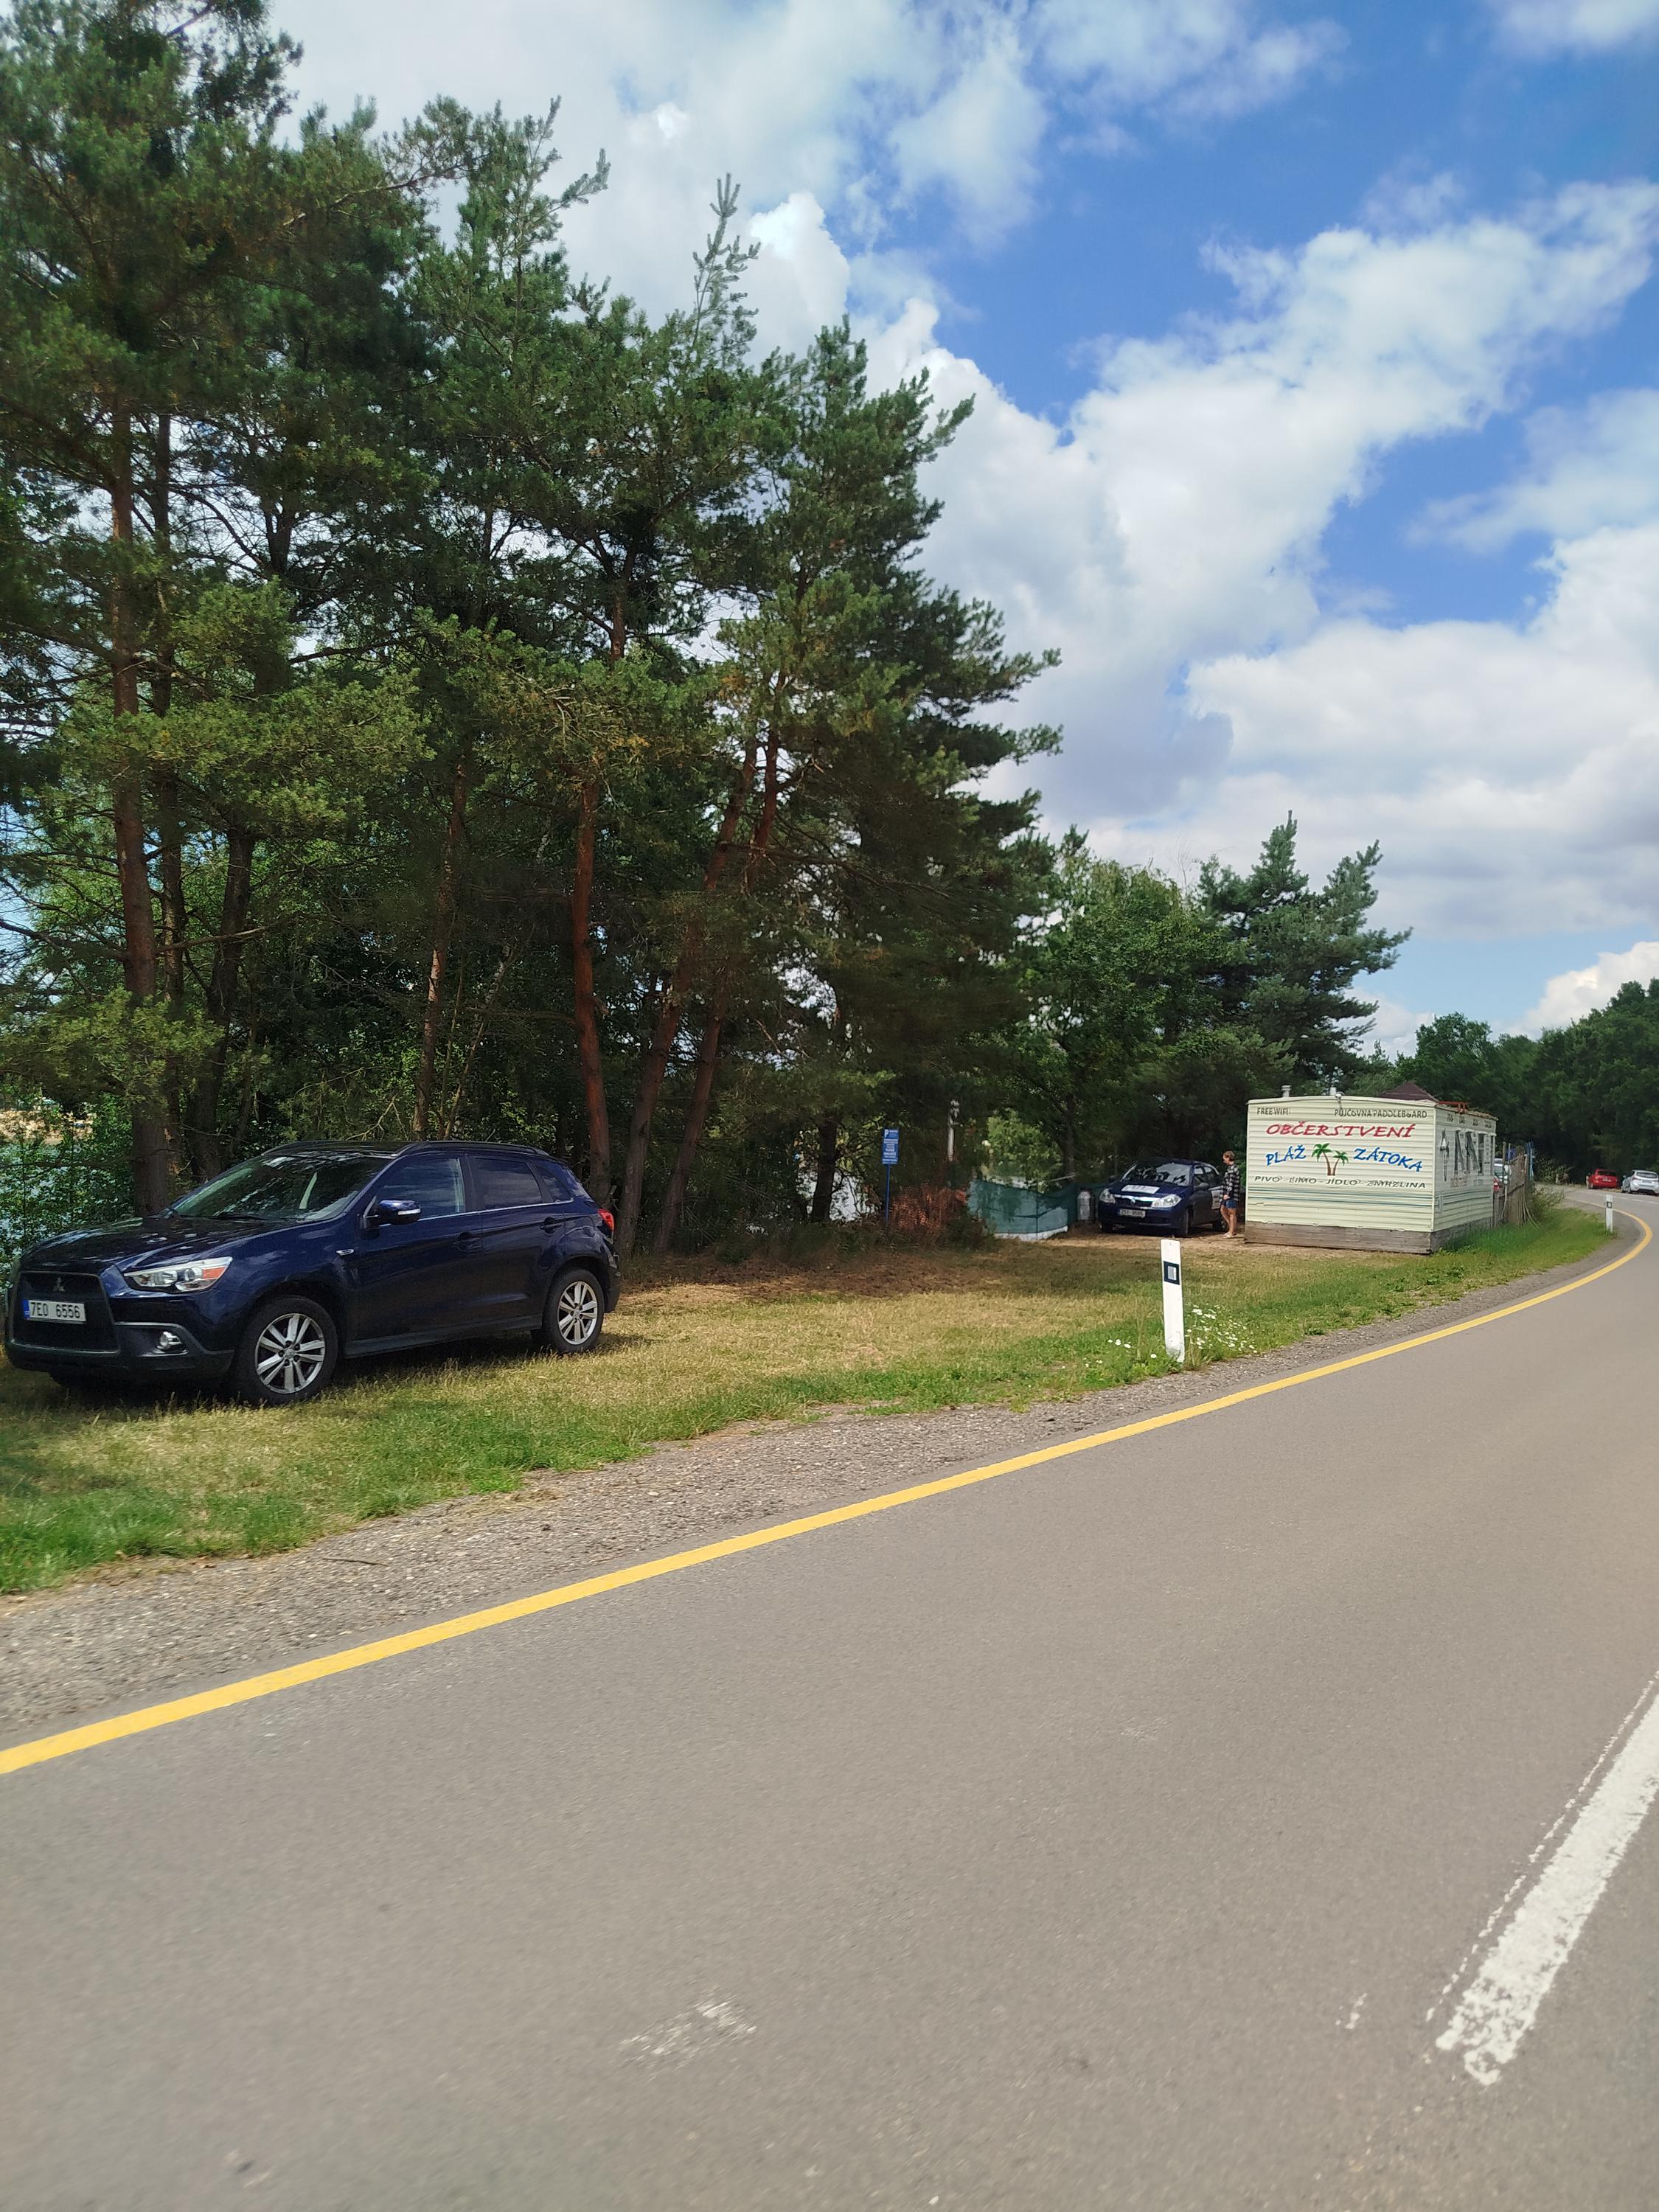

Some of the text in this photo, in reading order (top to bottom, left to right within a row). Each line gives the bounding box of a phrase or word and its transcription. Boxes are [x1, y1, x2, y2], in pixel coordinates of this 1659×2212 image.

[1266, 1121, 1416, 1138] OBČERSTVENÍ
[1353, 1147, 1423, 1172] ZÁTOKA
[1288, 1176, 1317, 1184] LIMO
[1366, 1180, 1426, 1189] ZMRZLINA
[55, 1304, 80, 1319] 6556
